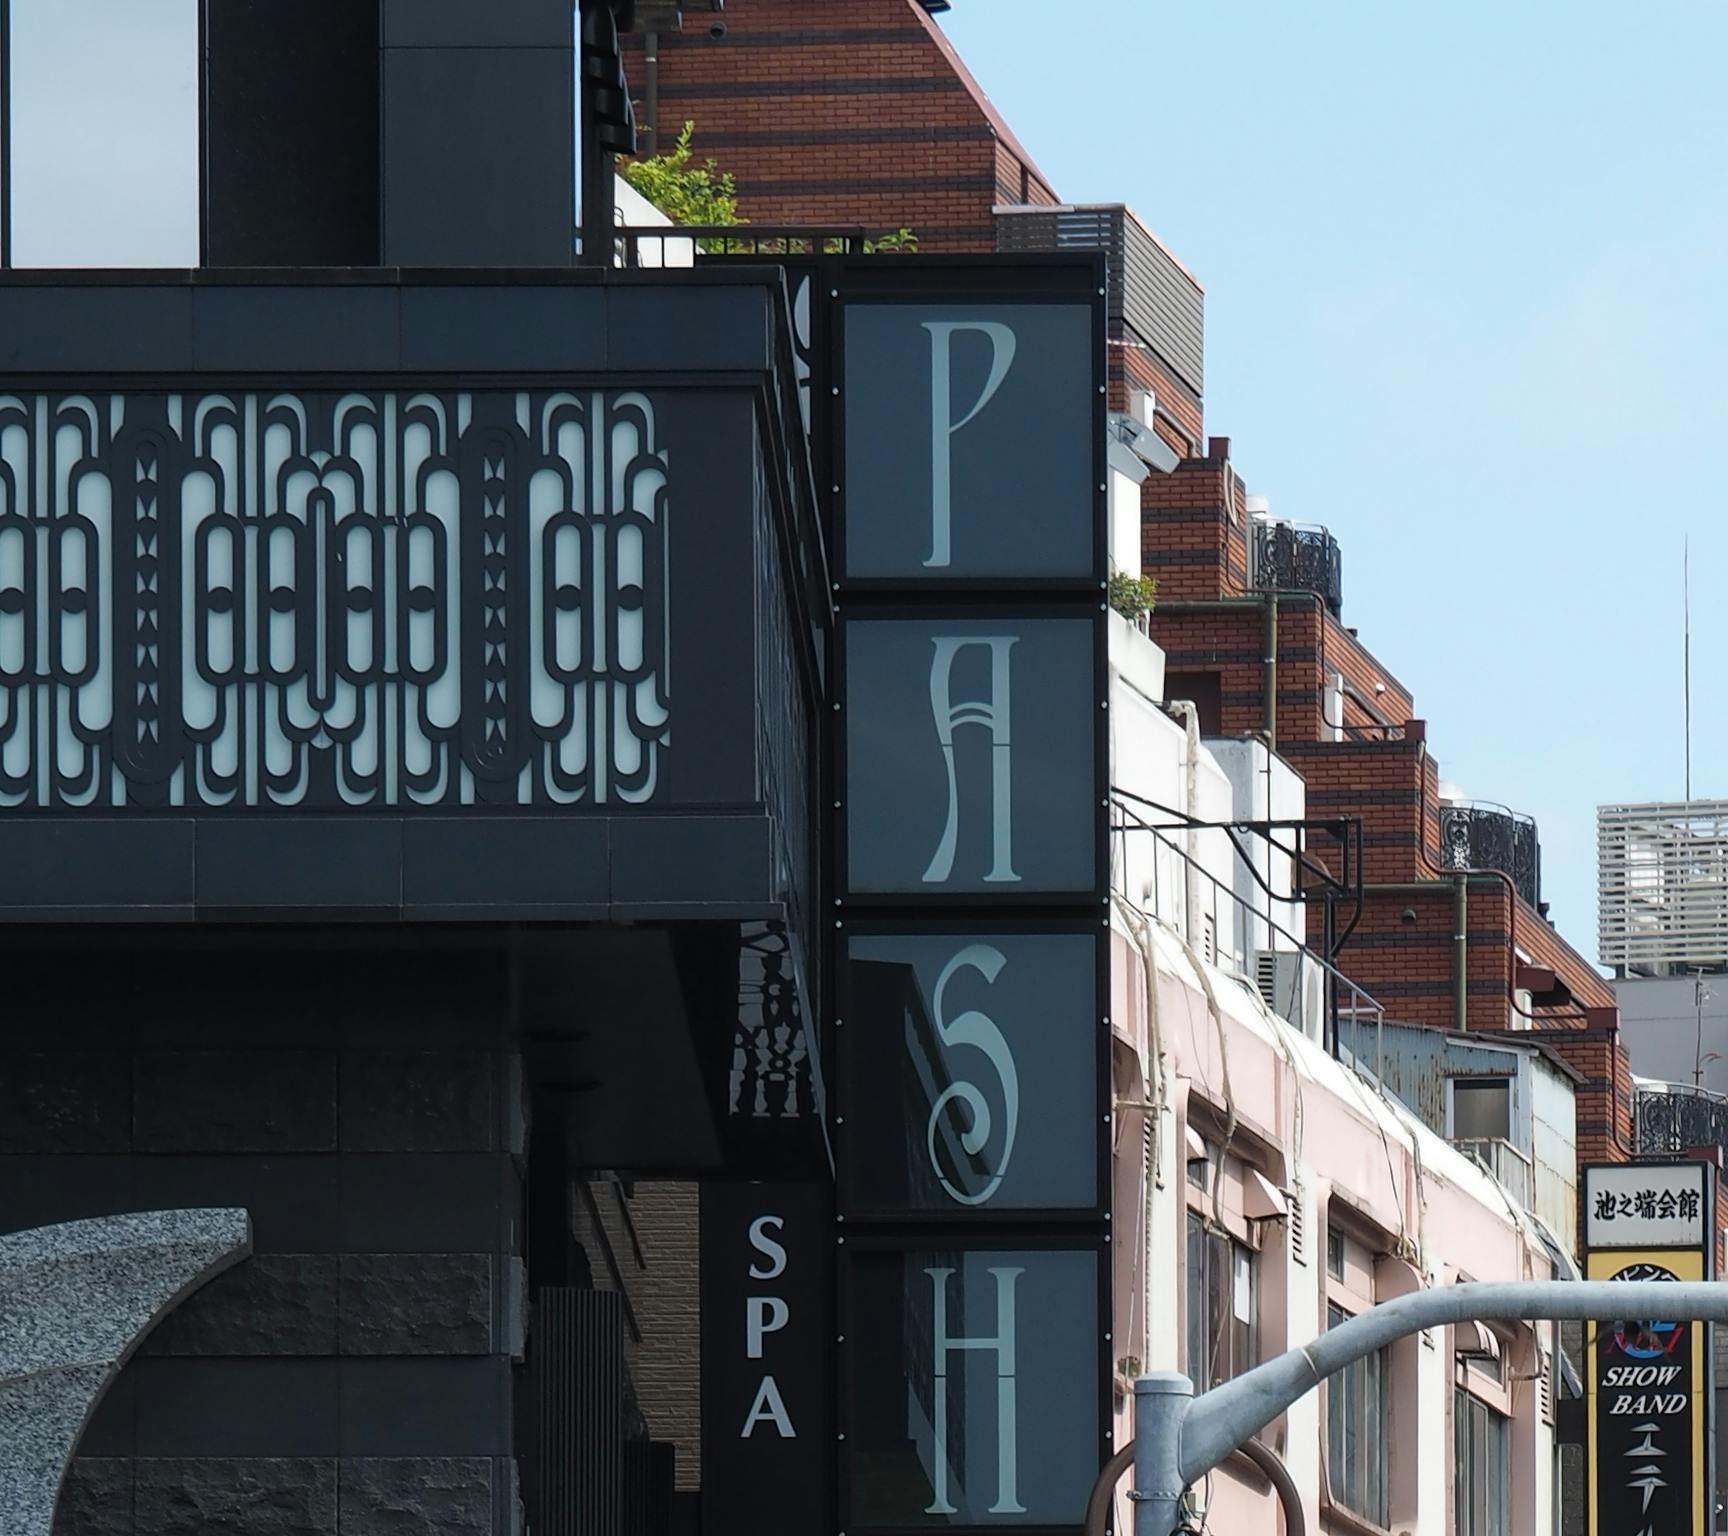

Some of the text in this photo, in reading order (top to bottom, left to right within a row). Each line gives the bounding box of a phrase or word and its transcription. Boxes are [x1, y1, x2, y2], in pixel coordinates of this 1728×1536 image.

[1594, 1189, 1700, 1221] 池之端会館
[740, 1215, 797, 1439] SPA
[1602, 1365, 1682, 1388] SHOW
[1609, 1394, 1688, 1415] BAND
